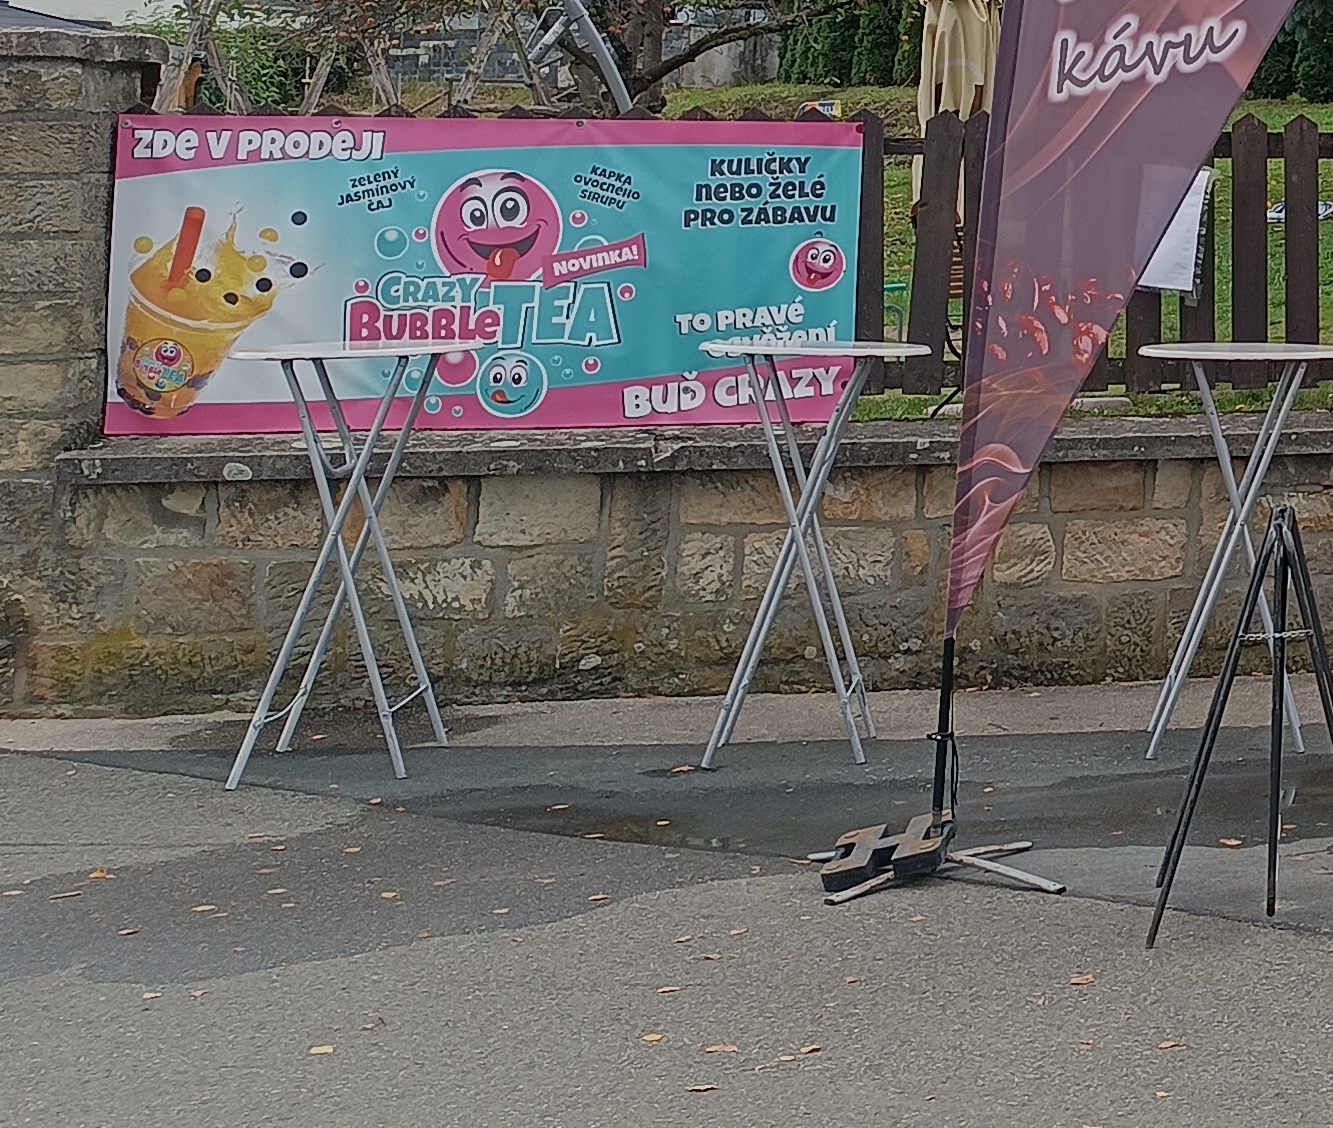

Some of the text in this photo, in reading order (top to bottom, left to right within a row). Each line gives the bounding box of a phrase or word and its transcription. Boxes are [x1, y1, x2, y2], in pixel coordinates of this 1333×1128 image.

[1053, 18, 1243, 98] kávu
[207, 129, 233, 160] V
[590, 164, 633, 187] KAPKA
[709, 153, 811, 178] KULIČKY
[367, 197, 393, 212] ČAJ
[579, 188, 627, 211] SIRUPU
[683, 198, 838, 228] PRO ZÁBAVU
[491, 281, 621, 349] TEA
[675, 313, 712, 334] TO
[624, 366, 842, 419] BUĎ CRAZY
